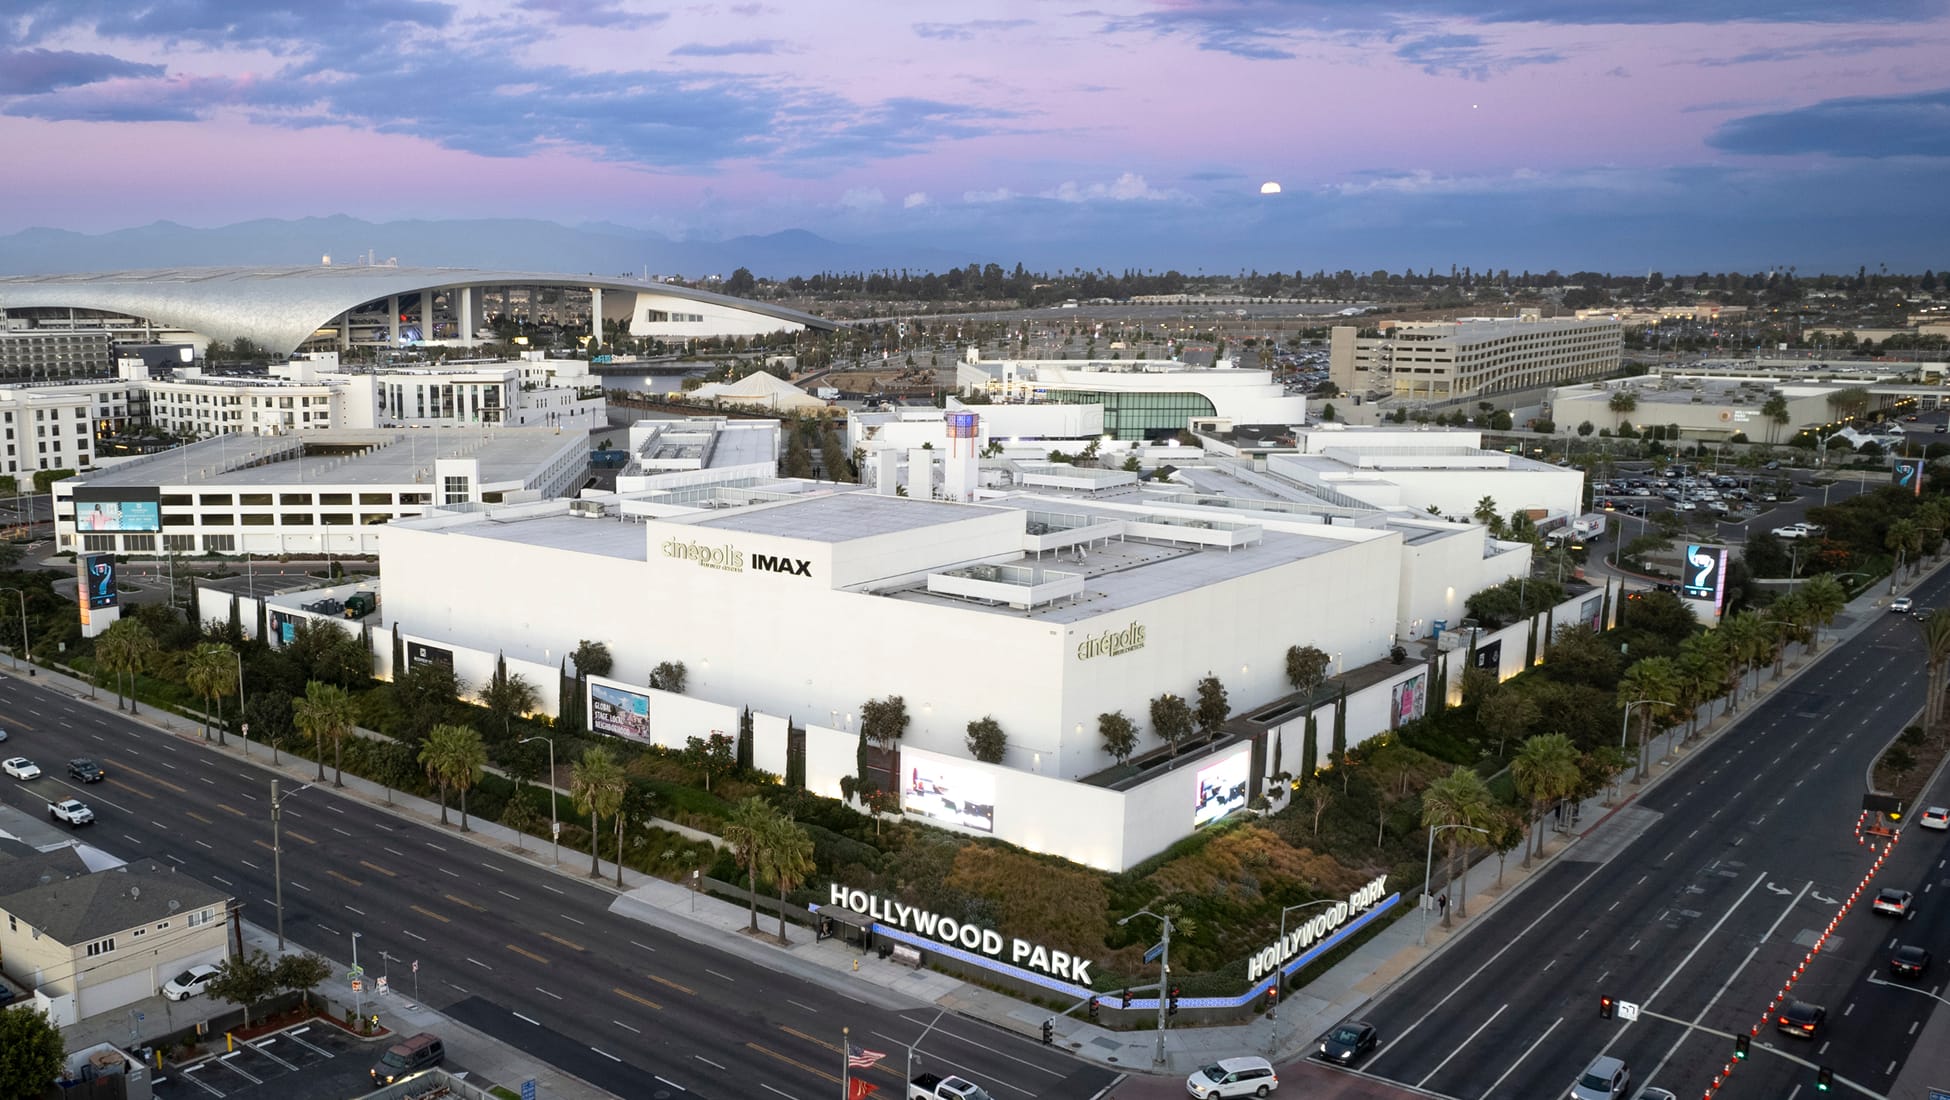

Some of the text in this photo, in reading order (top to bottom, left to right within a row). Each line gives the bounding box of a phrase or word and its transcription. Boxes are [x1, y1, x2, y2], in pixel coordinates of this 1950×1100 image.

[661, 536, 744, 567] cinépolis
[752, 554, 812, 577] IMAX
[1077, 620, 1145, 661] cinépolis
[830, 883, 1093, 985] HOLLYWOOD PARK
[1248, 874, 1388, 981] HOLLYWOOD PARK
